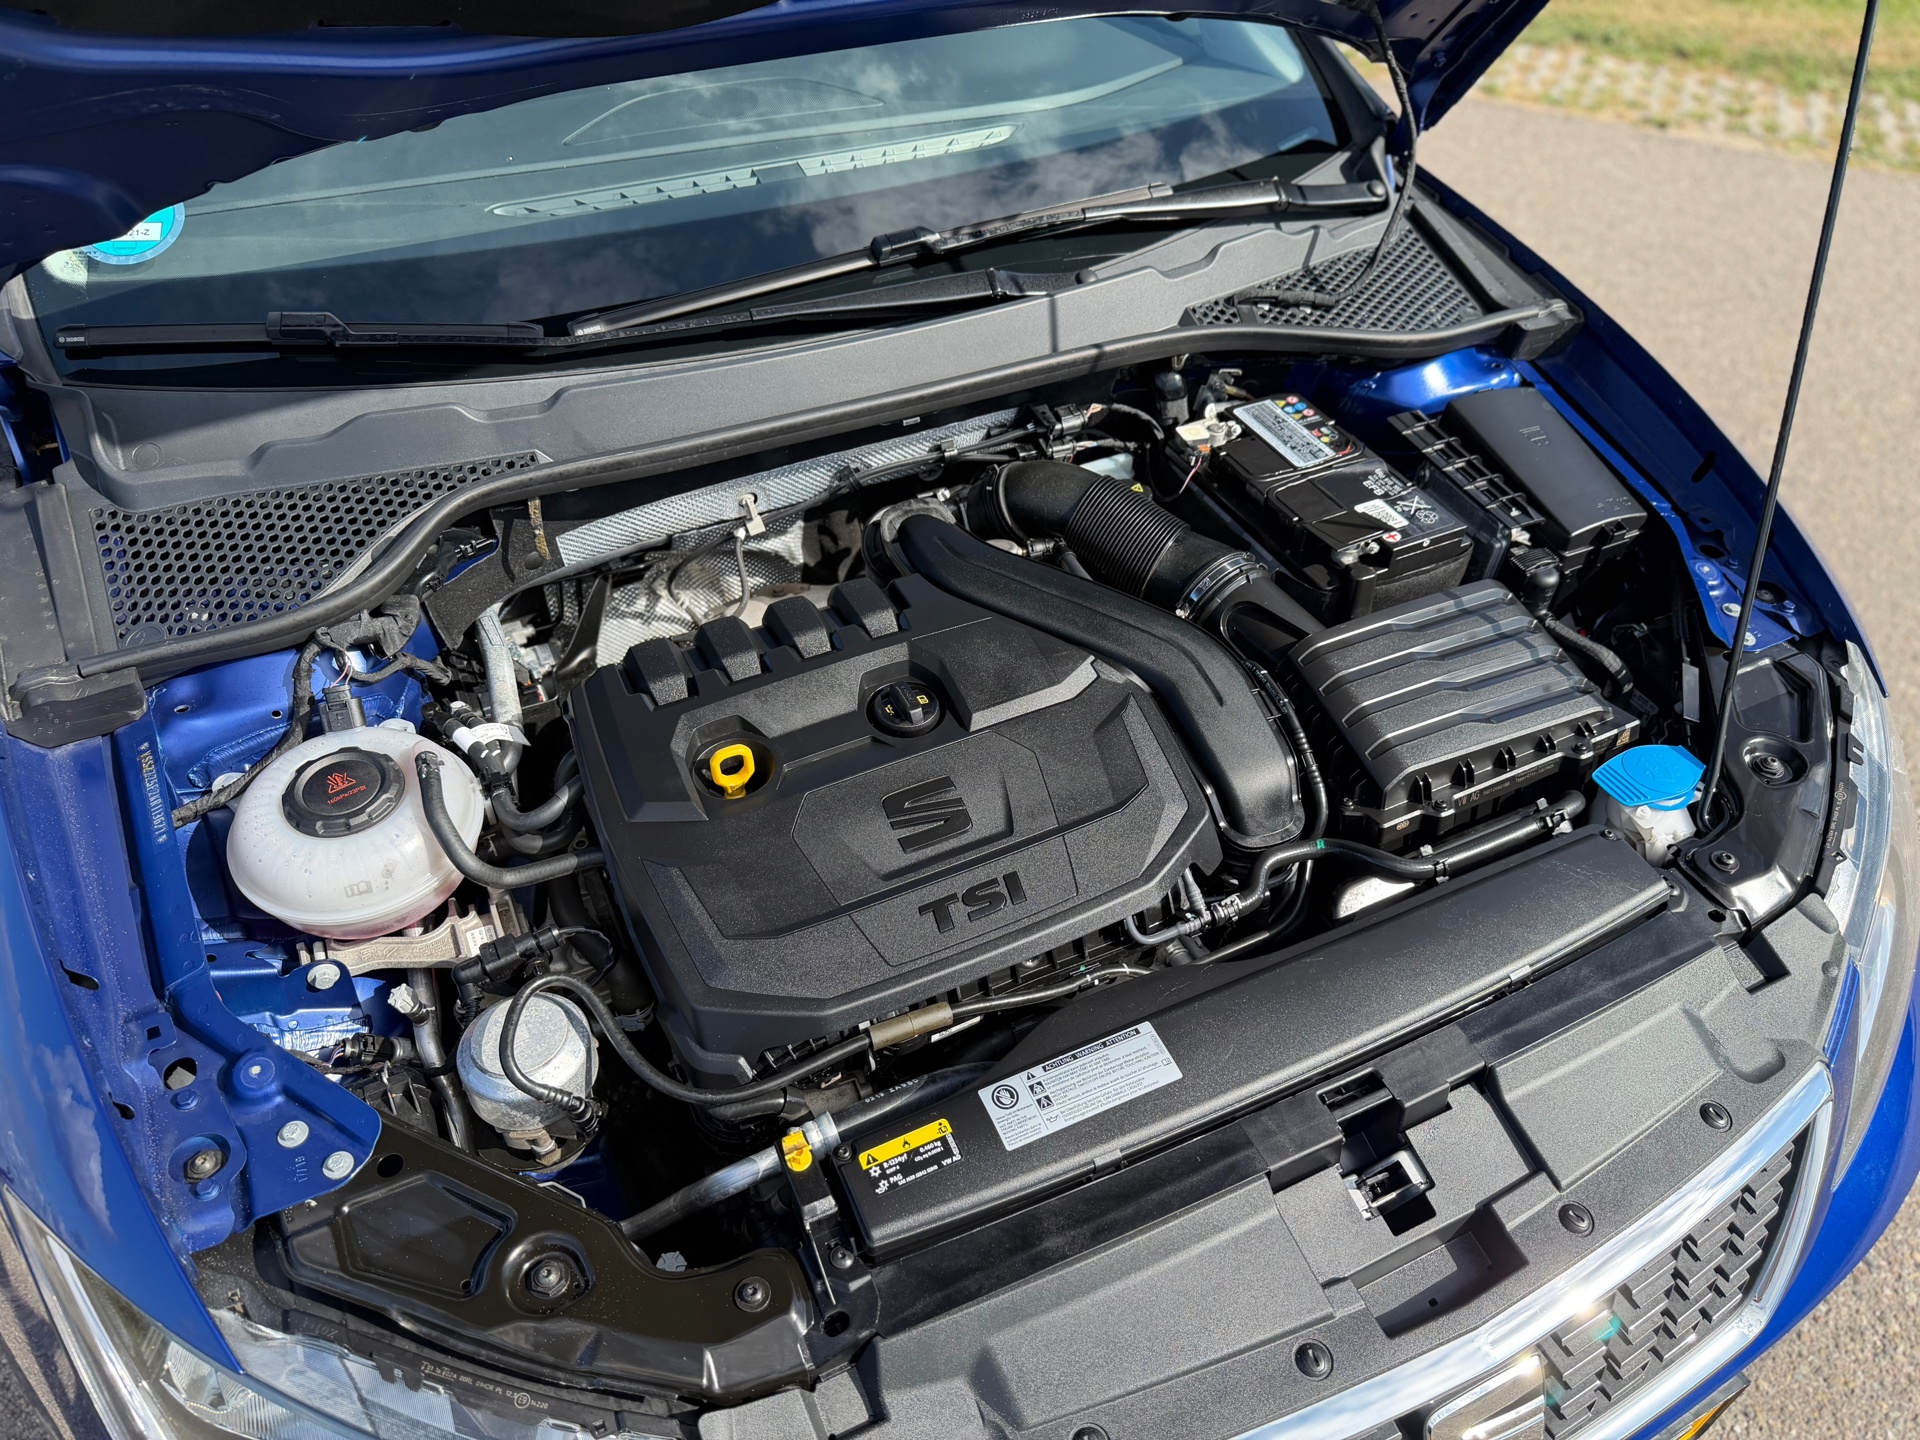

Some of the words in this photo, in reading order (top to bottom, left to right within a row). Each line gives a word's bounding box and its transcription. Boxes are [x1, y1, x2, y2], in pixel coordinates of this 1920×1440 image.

[1363, 480, 1384, 496] EFB
[919, 870, 1029, 934] TSI
[1044, 1055, 1074, 1071] ACHTUNG
[1074, 1042, 1104, 1058] WARNING
[1104, 1029, 1137, 1046] ATTENTION
[882, 1153, 908, 1169] R-1234yf
[941, 1157, 952, 1166] VW
[951, 1153, 961, 1161] AG
[889, 1173, 903, 1183] PAG
